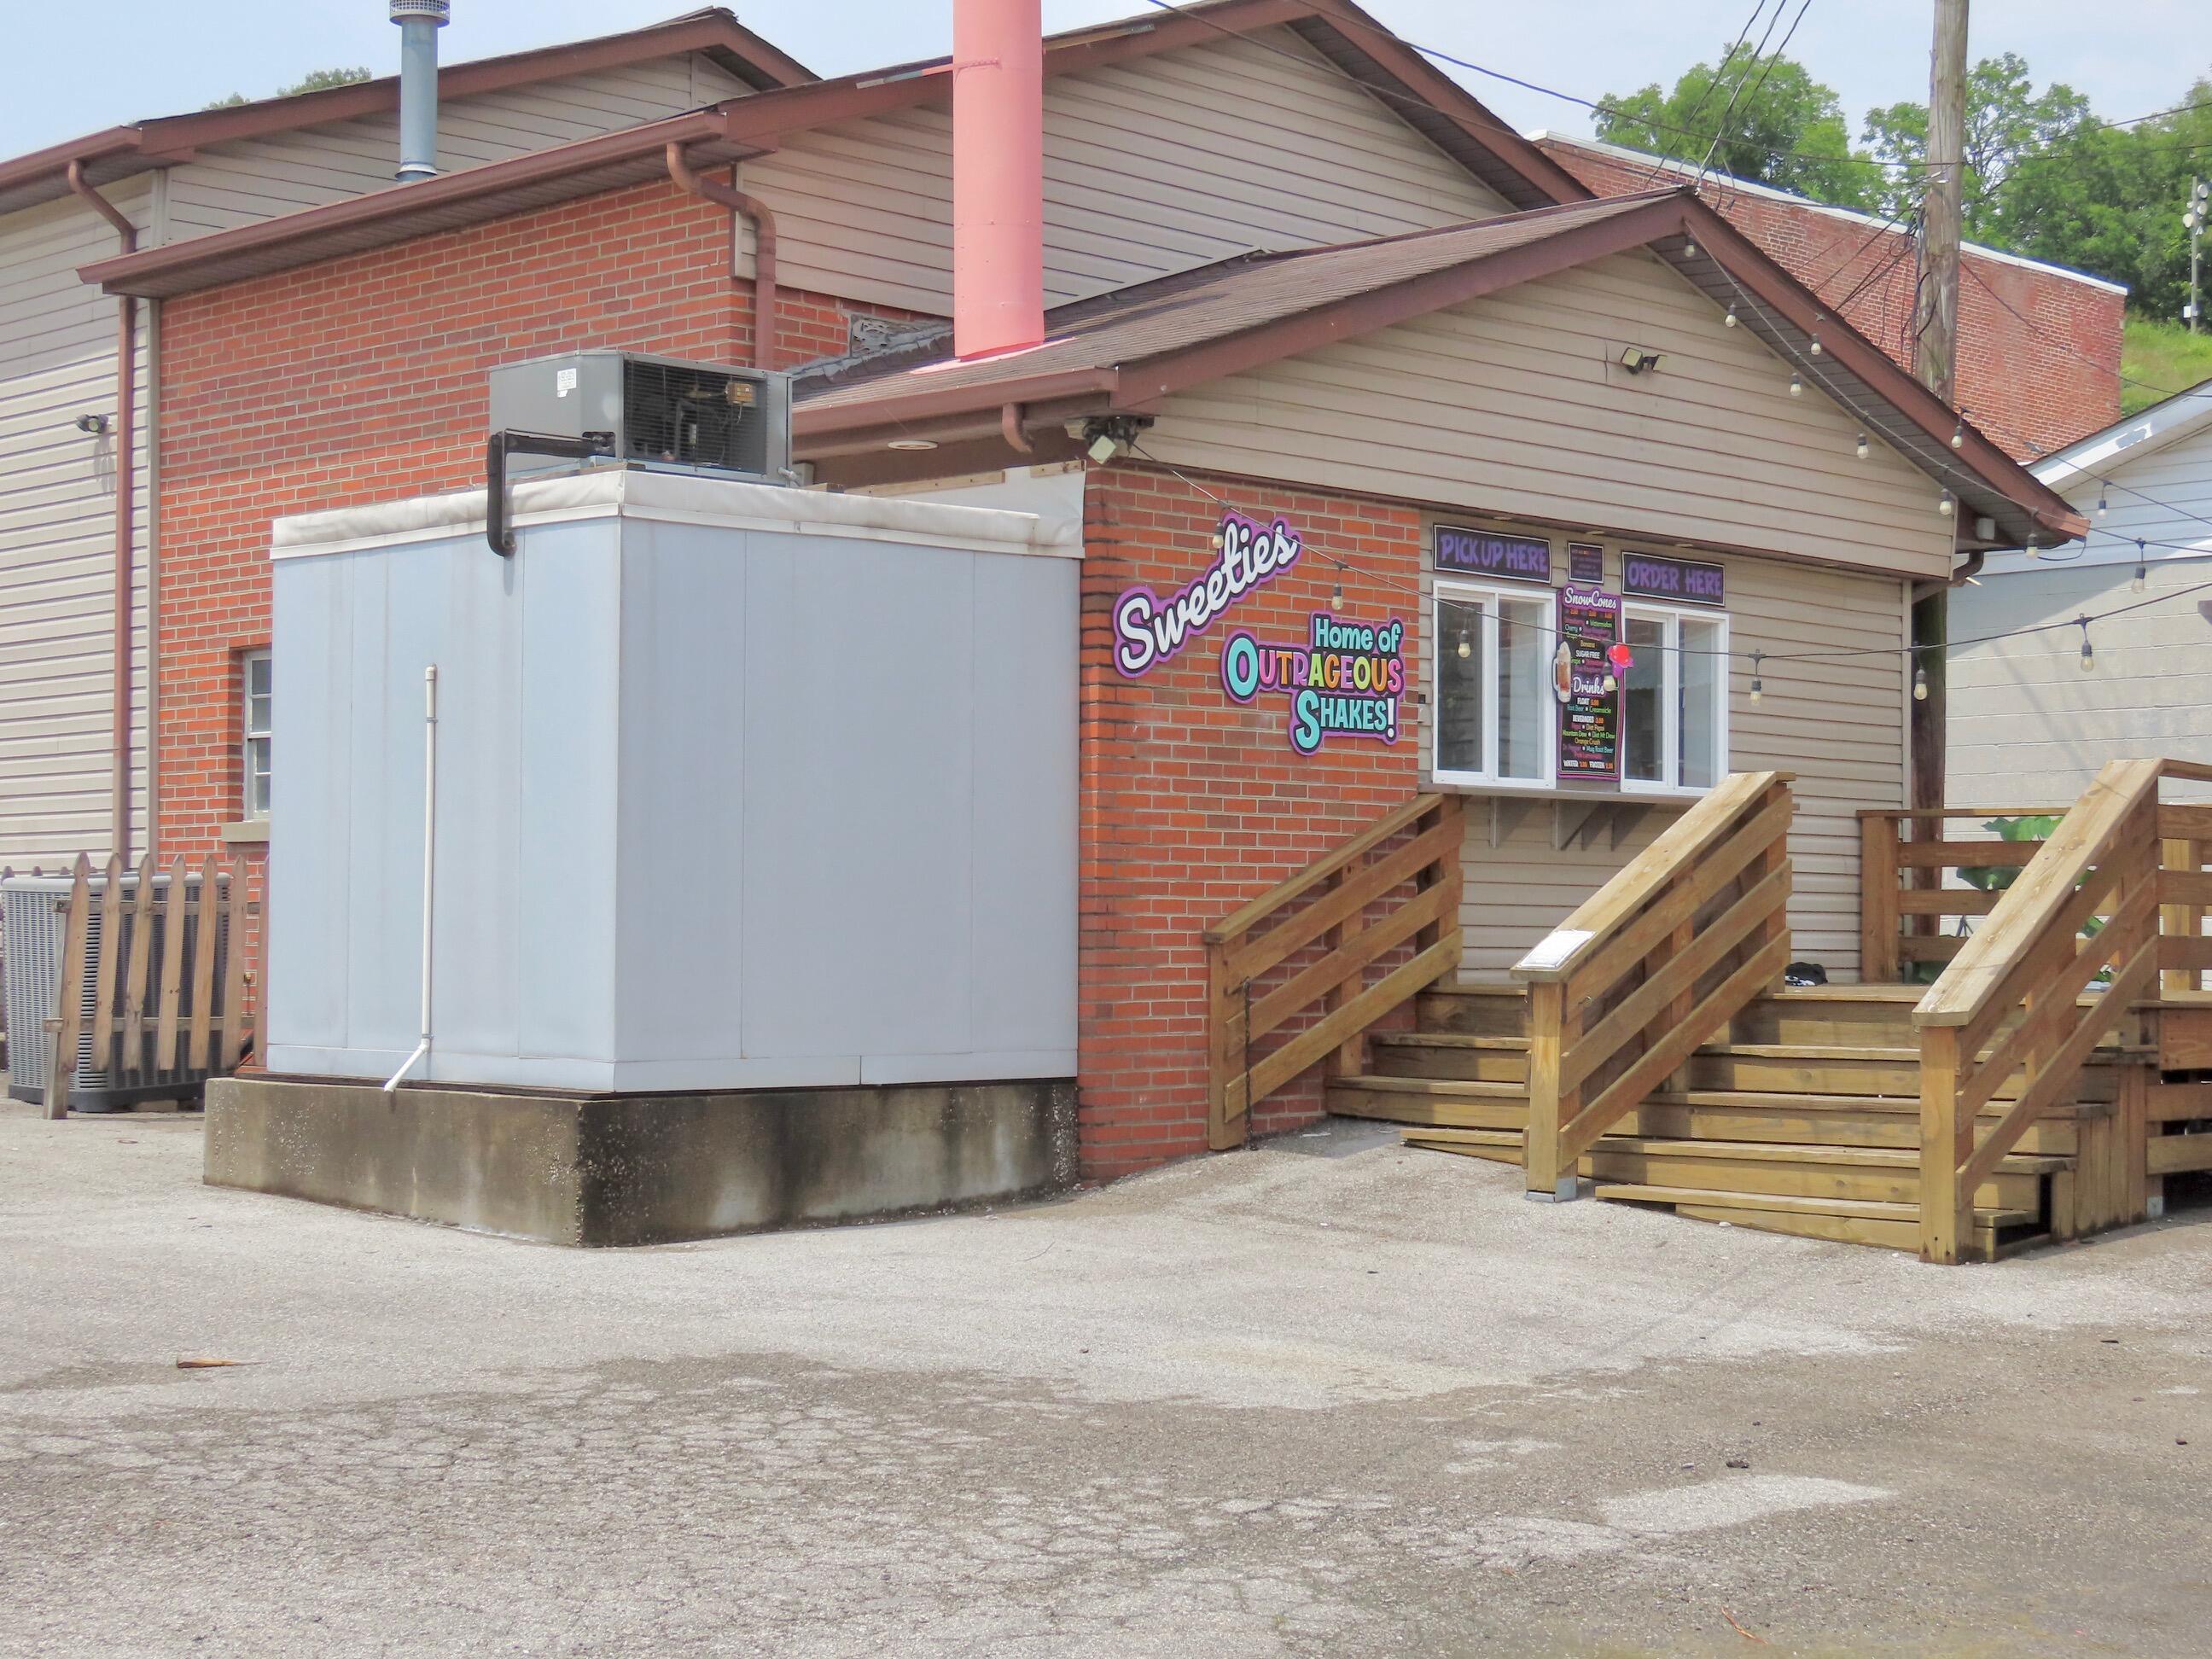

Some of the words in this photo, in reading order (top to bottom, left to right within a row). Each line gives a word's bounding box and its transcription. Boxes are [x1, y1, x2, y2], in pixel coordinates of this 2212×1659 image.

[1440, 534, 1478, 563] PICK
[1481, 539, 1503, 568] UP
[1505, 544, 1549, 574] HERE
[1119, 522, 1298, 670] Sweeties
[1627, 561, 1679, 592] ORDER
[1685, 568, 1723, 597] HERE
[1314, 617, 1374, 651] Home
[1377, 622, 1402, 654] of
[1575, 649, 1589, 658] SUGAR
[1590, 650, 1601, 660] FREE
[1226, 636, 1402, 697] OUTRAGEOUS
[1572, 676, 1605, 696] Drinks
[1295, 689, 1396, 750] SHAKES!
